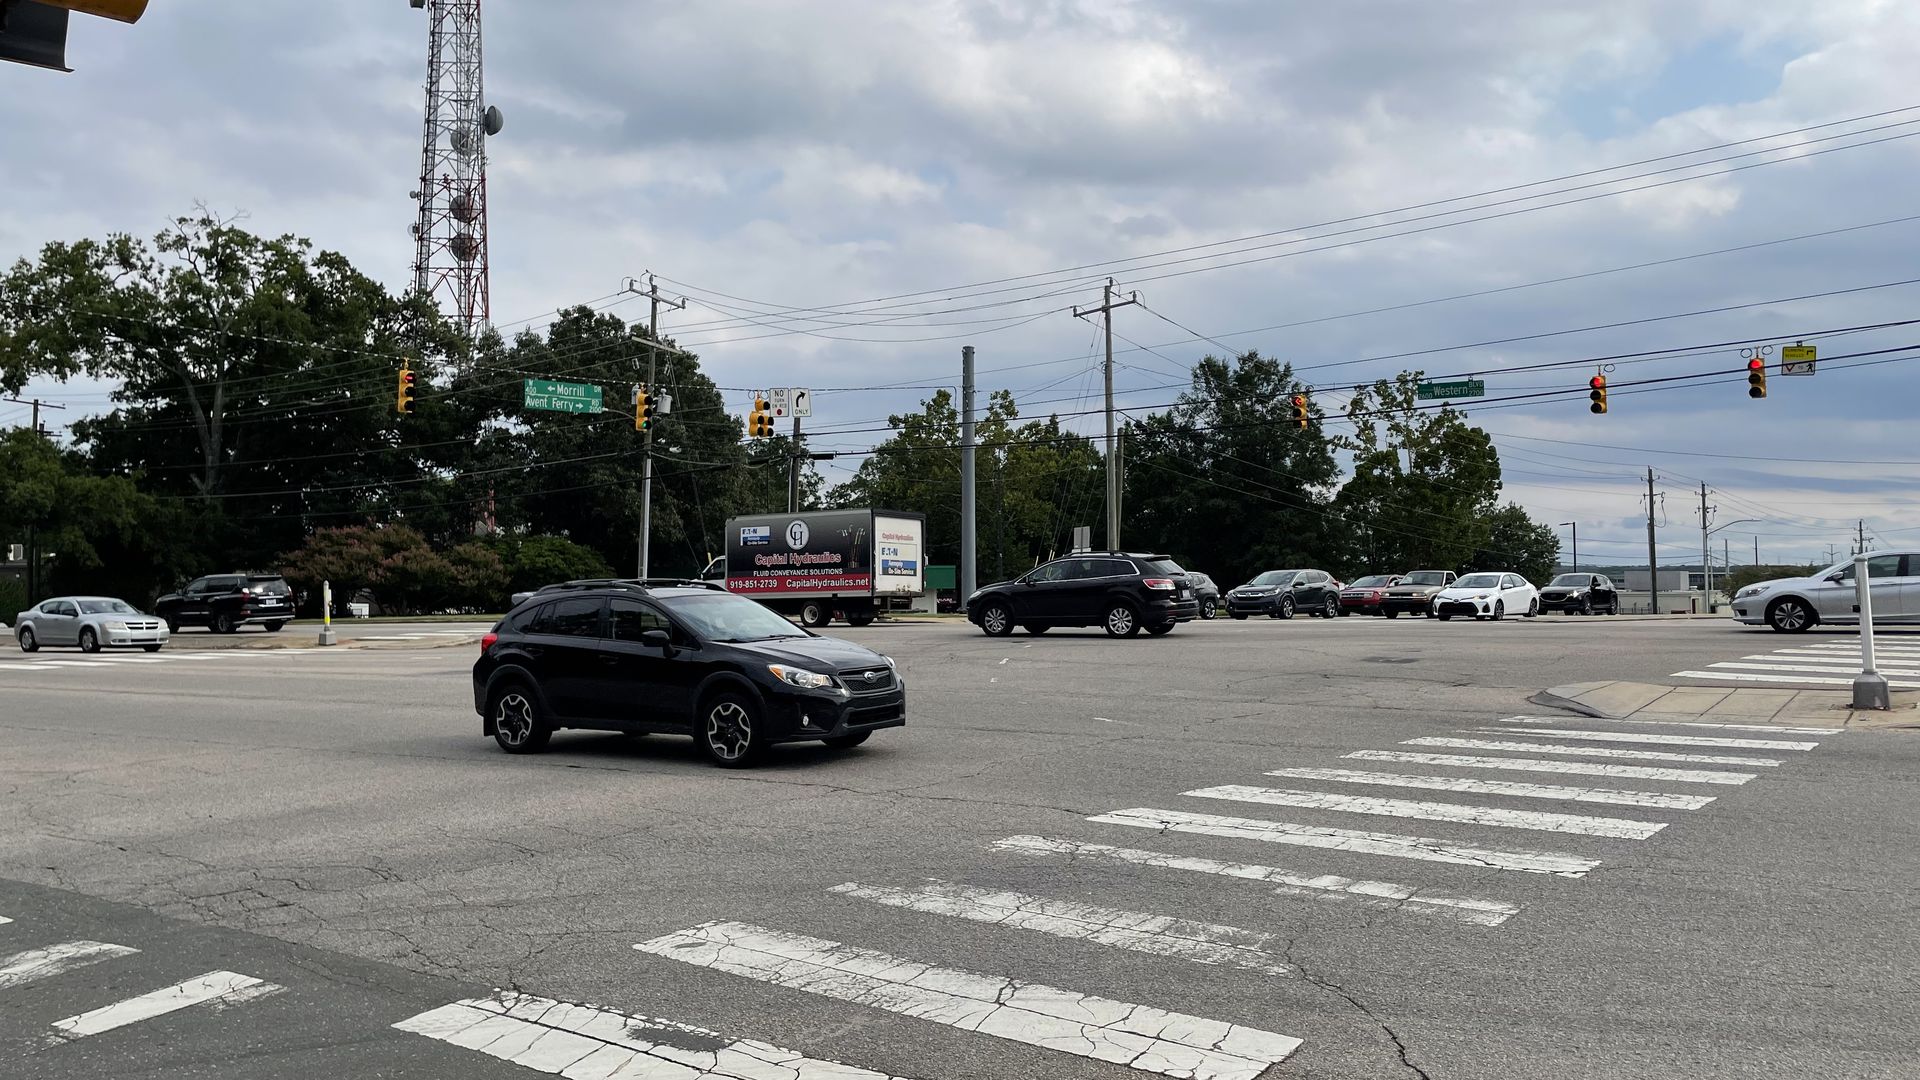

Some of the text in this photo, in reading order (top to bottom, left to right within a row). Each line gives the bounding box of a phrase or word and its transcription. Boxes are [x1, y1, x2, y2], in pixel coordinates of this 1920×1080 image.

[557, 384, 585, 397] Morrill
[594, 385, 602, 393] DR
[1433, 386, 1468, 396] Western
[525, 396, 574, 412] Avent Ferry
[754, 551, 842, 567] Capital Hydraulics
[729, 579, 777, 589] 919-851-2739
[786, 577, 869, 589] CapitalHydraulics.net
